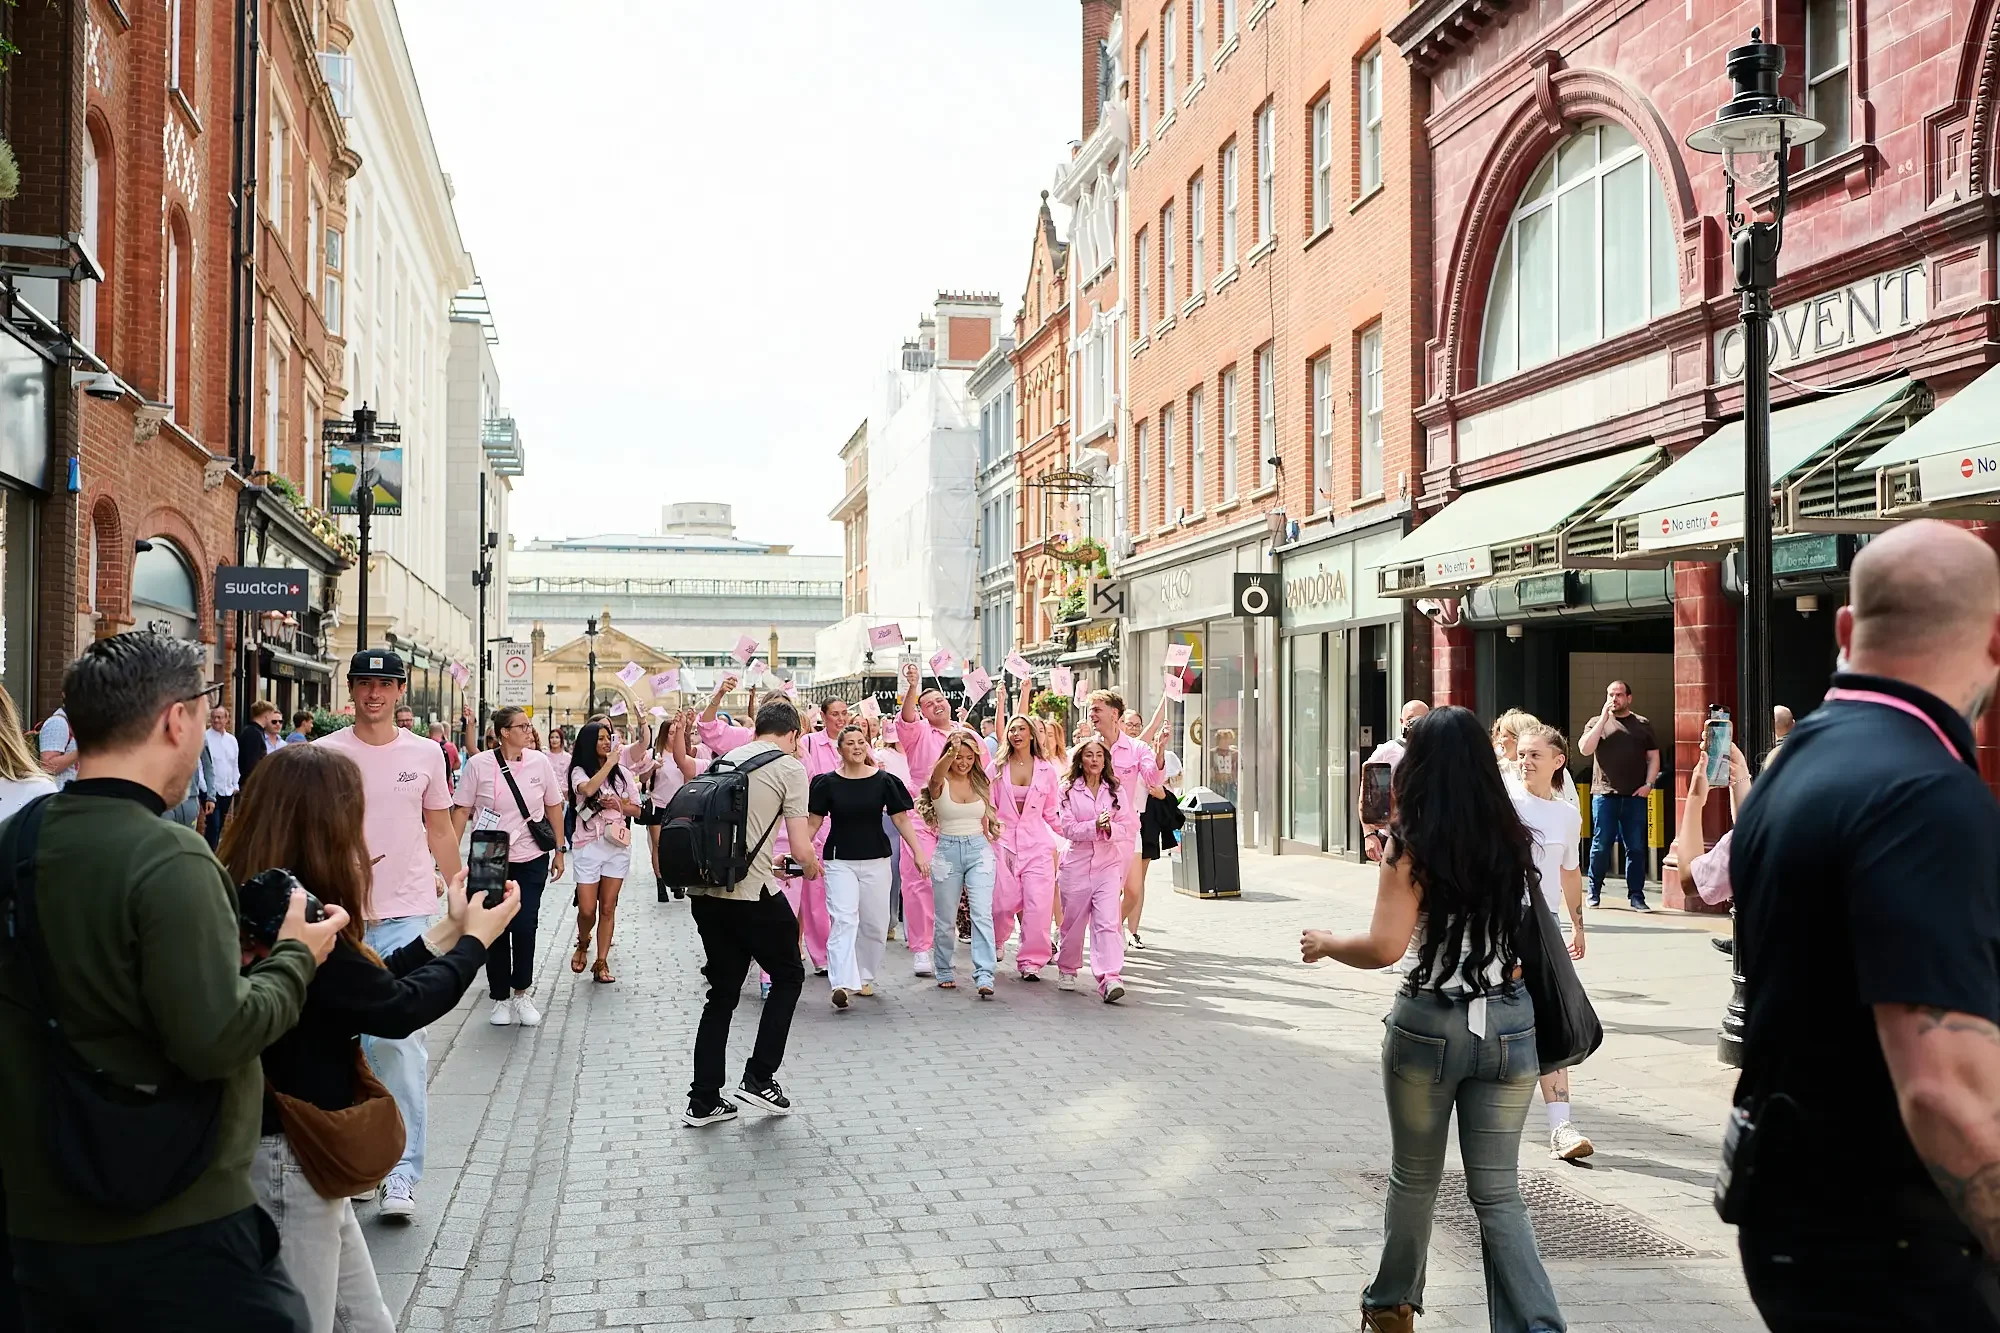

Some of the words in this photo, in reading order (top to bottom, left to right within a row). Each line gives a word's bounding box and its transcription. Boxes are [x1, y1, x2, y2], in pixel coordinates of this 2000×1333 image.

[1977, 456, 1997, 473] No
[331, 505, 349, 514] THE
[376, 506, 401, 515] HEAD
[1672, 518, 1684, 531] No
[1686, 516, 1708, 530] entry
[1444, 563, 1453, 574] No
[1453, 561, 1469, 574] entry
[1788, 558, 1797, 567] Do
[225, 581, 289, 595] swatch
[1161, 568, 1193, 603] KIKO
[1286, 569, 1346, 608] PANDORA
[396, 771, 418, 783] Boots
